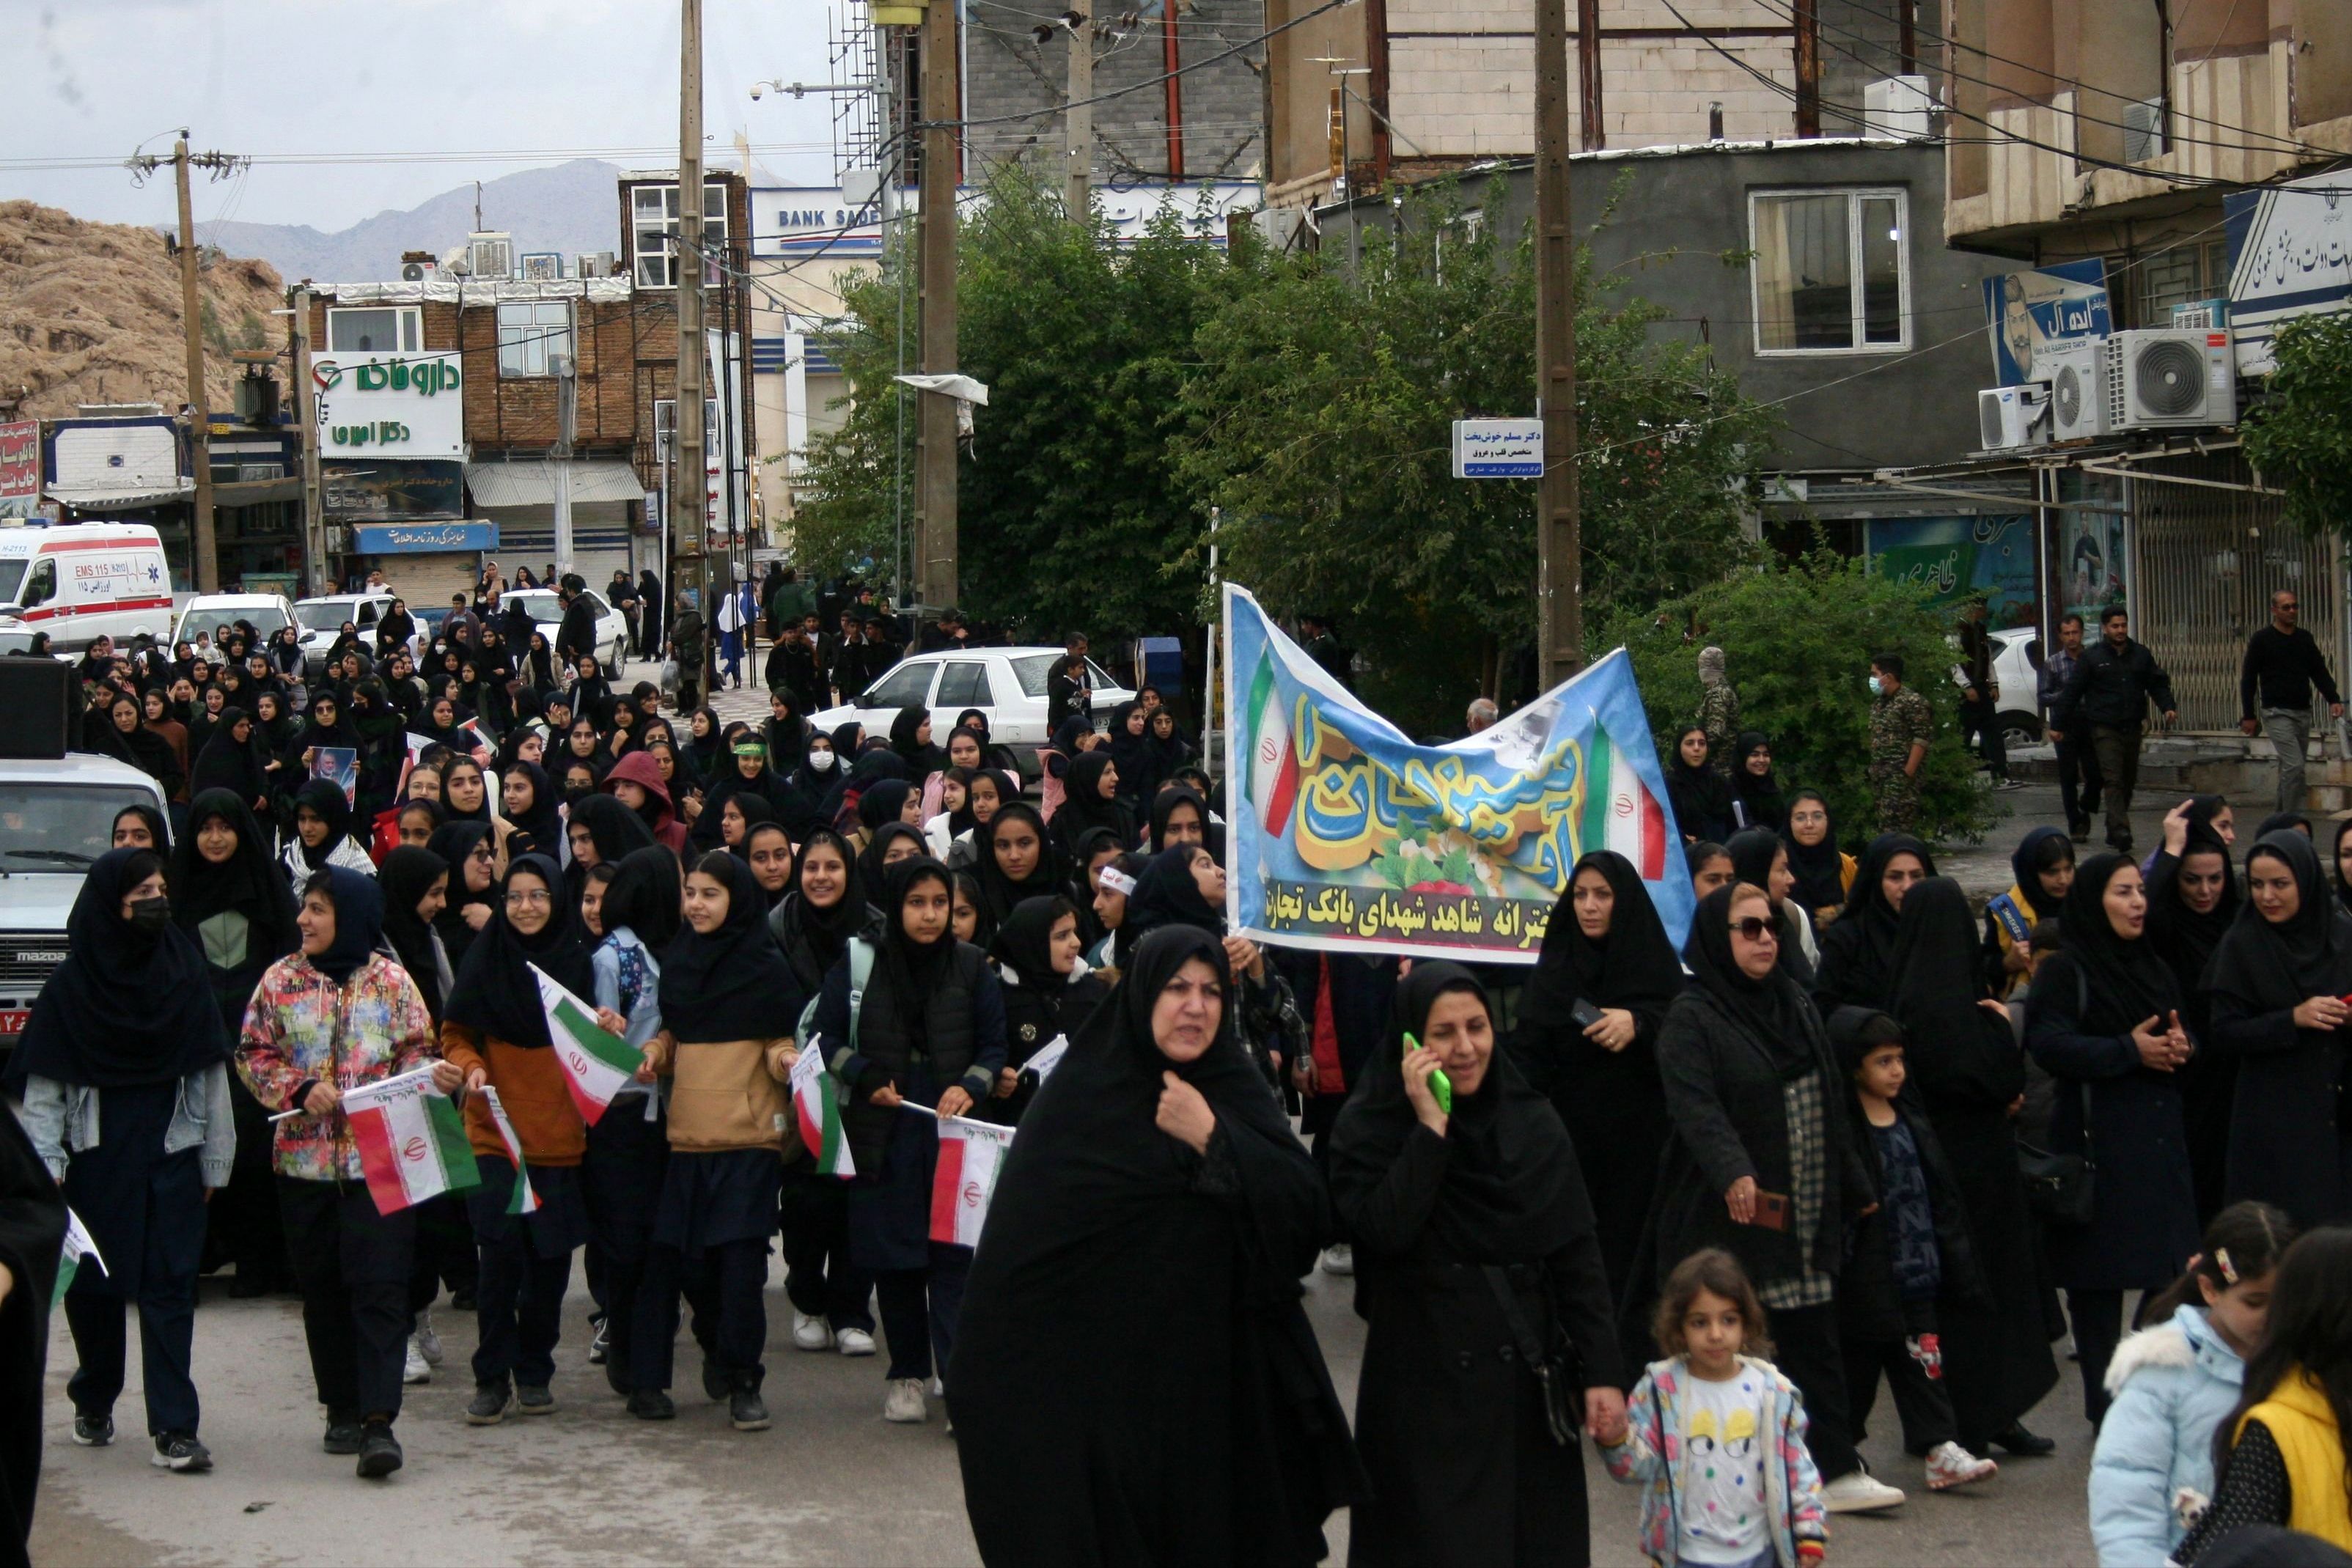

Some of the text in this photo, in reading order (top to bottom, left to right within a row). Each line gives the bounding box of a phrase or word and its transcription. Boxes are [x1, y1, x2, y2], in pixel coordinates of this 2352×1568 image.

[779, 210, 826, 227] BANK
[2276, 229, 2293, 285] بخش
[2253, 246, 2271, 289] عمومی
[357, 357, 460, 397] داروخانه
[332, 422, 411, 446] دکتر امیری
[1504, 433, 1521, 441] مسلم
[1524, 432, 1541, 443] دکتر
[1473, 449, 1488, 457] عروق
[1508, 449, 1532, 457] متخصص
[18, 469, 36, 493] چاپ
[388, 530, 412, 543] اطلاعات
[439, 527, 465, 545] نمایندگی
[76, 564, 94, 578] EMS
[95, 563, 109, 575] 115
[78, 581, 88, 592] ۱۱۵
[1307, 887, 1355, 935] بانک
[1359, 891, 1427, 938] شهدای
[1432, 897, 1482, 935] شاهد
